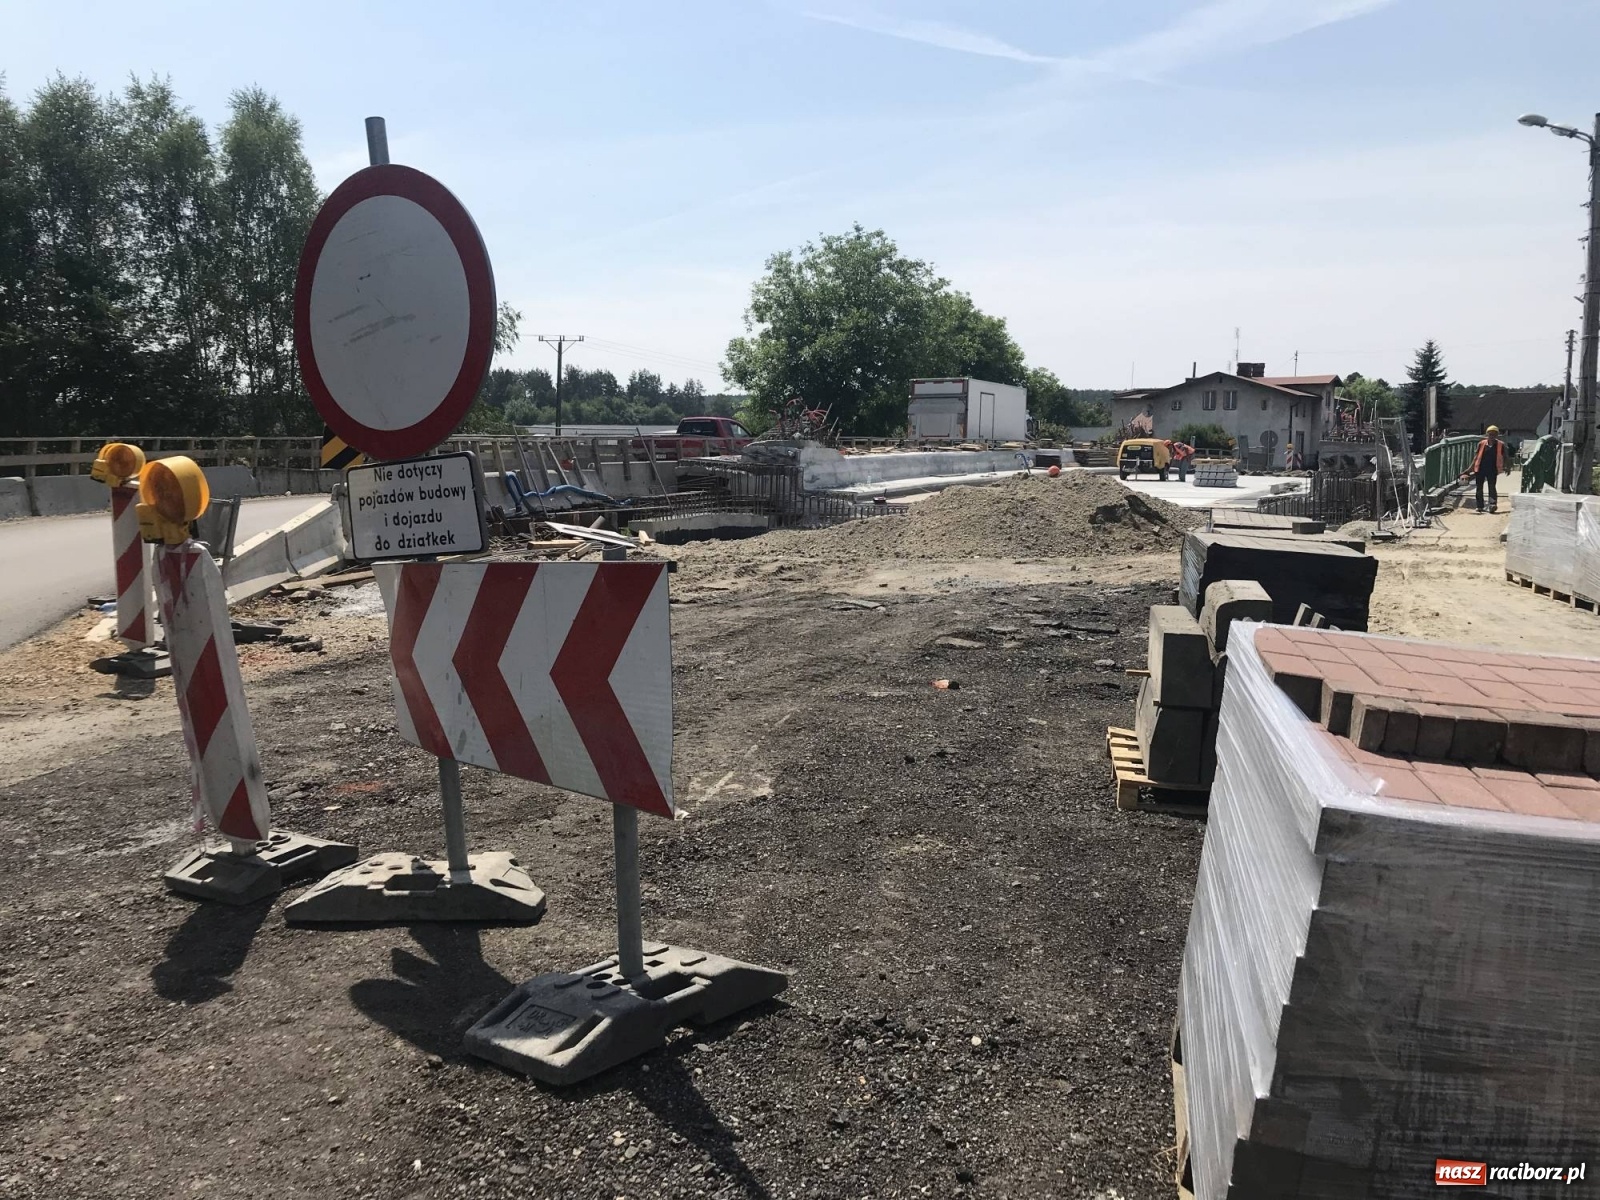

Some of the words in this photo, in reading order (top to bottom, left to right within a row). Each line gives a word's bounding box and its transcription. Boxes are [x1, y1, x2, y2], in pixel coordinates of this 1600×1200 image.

[373, 467, 393, 482] Nie
[397, 464, 443, 481] dotyczy
[359, 487, 414, 511] pojazdów
[419, 484, 467, 501] budowy
[384, 513, 388, 527] i
[392, 508, 443, 528] dojazdu
[374, 535, 390, 551] do
